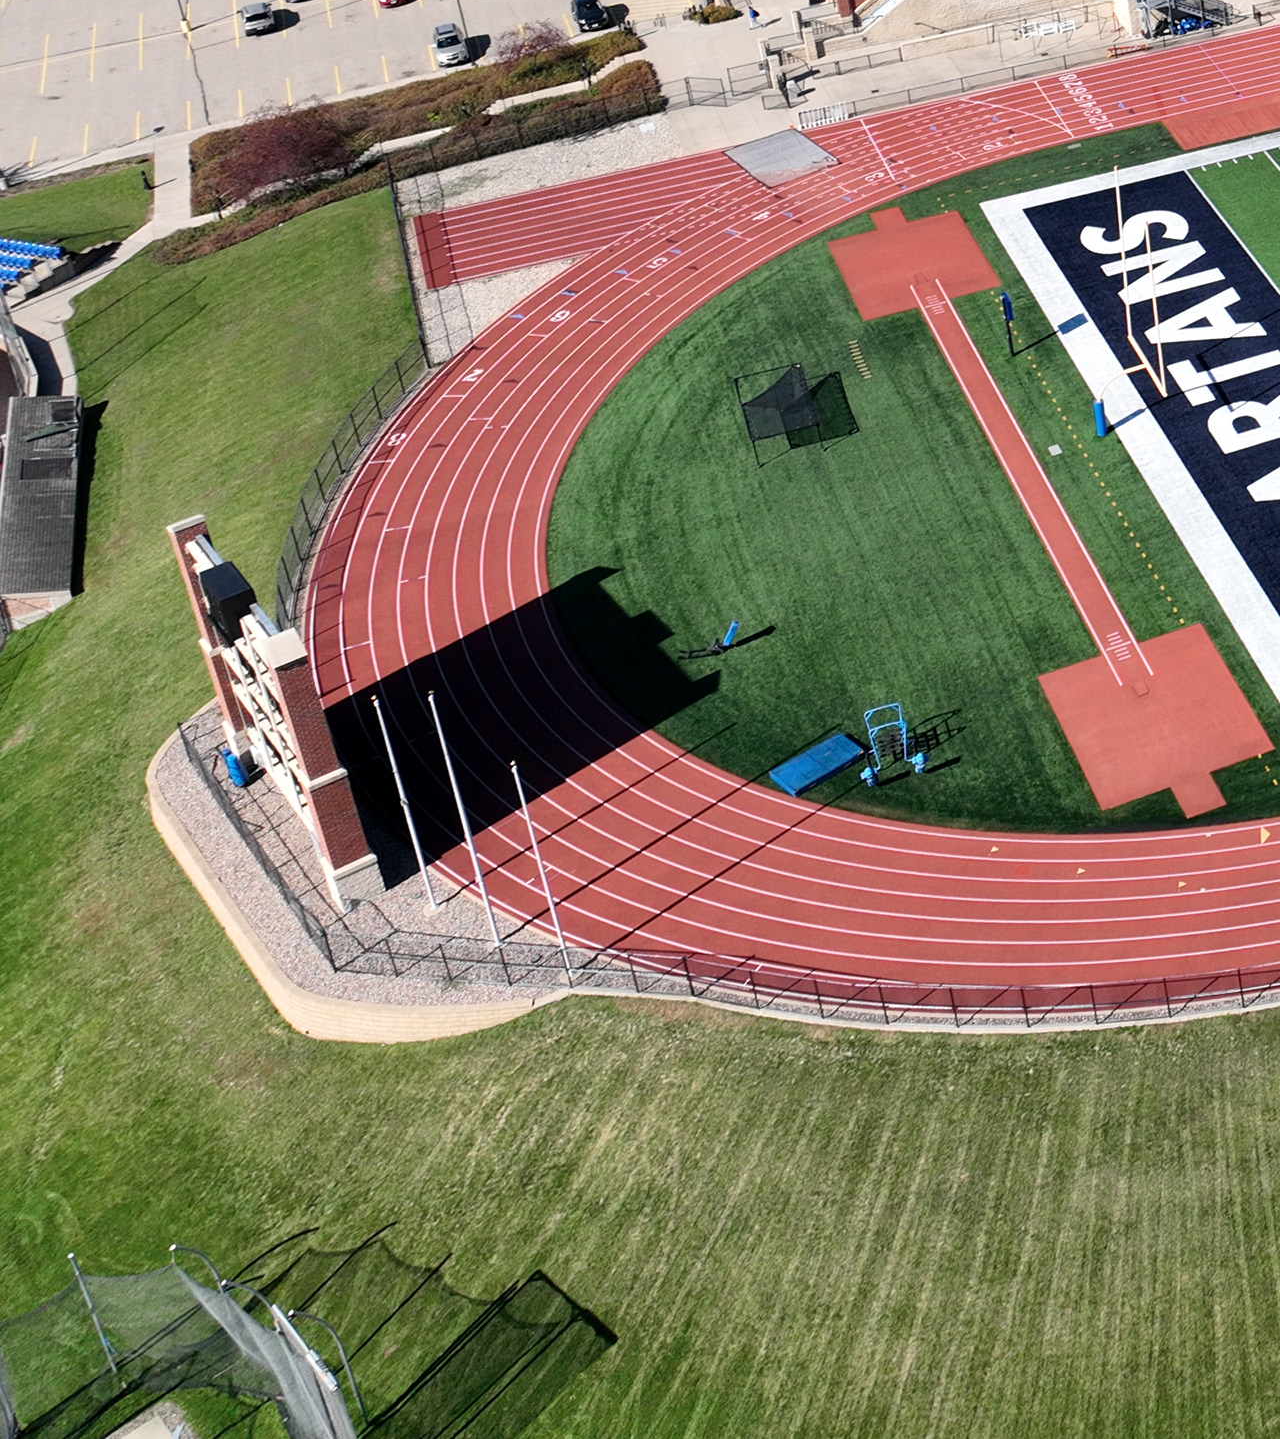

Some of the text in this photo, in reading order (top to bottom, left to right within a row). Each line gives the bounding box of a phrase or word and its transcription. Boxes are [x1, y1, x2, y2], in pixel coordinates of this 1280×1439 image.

[647, 256, 668, 269] 5
[549, 309, 571, 323] 6
[388, 432, 407, 447] 8
